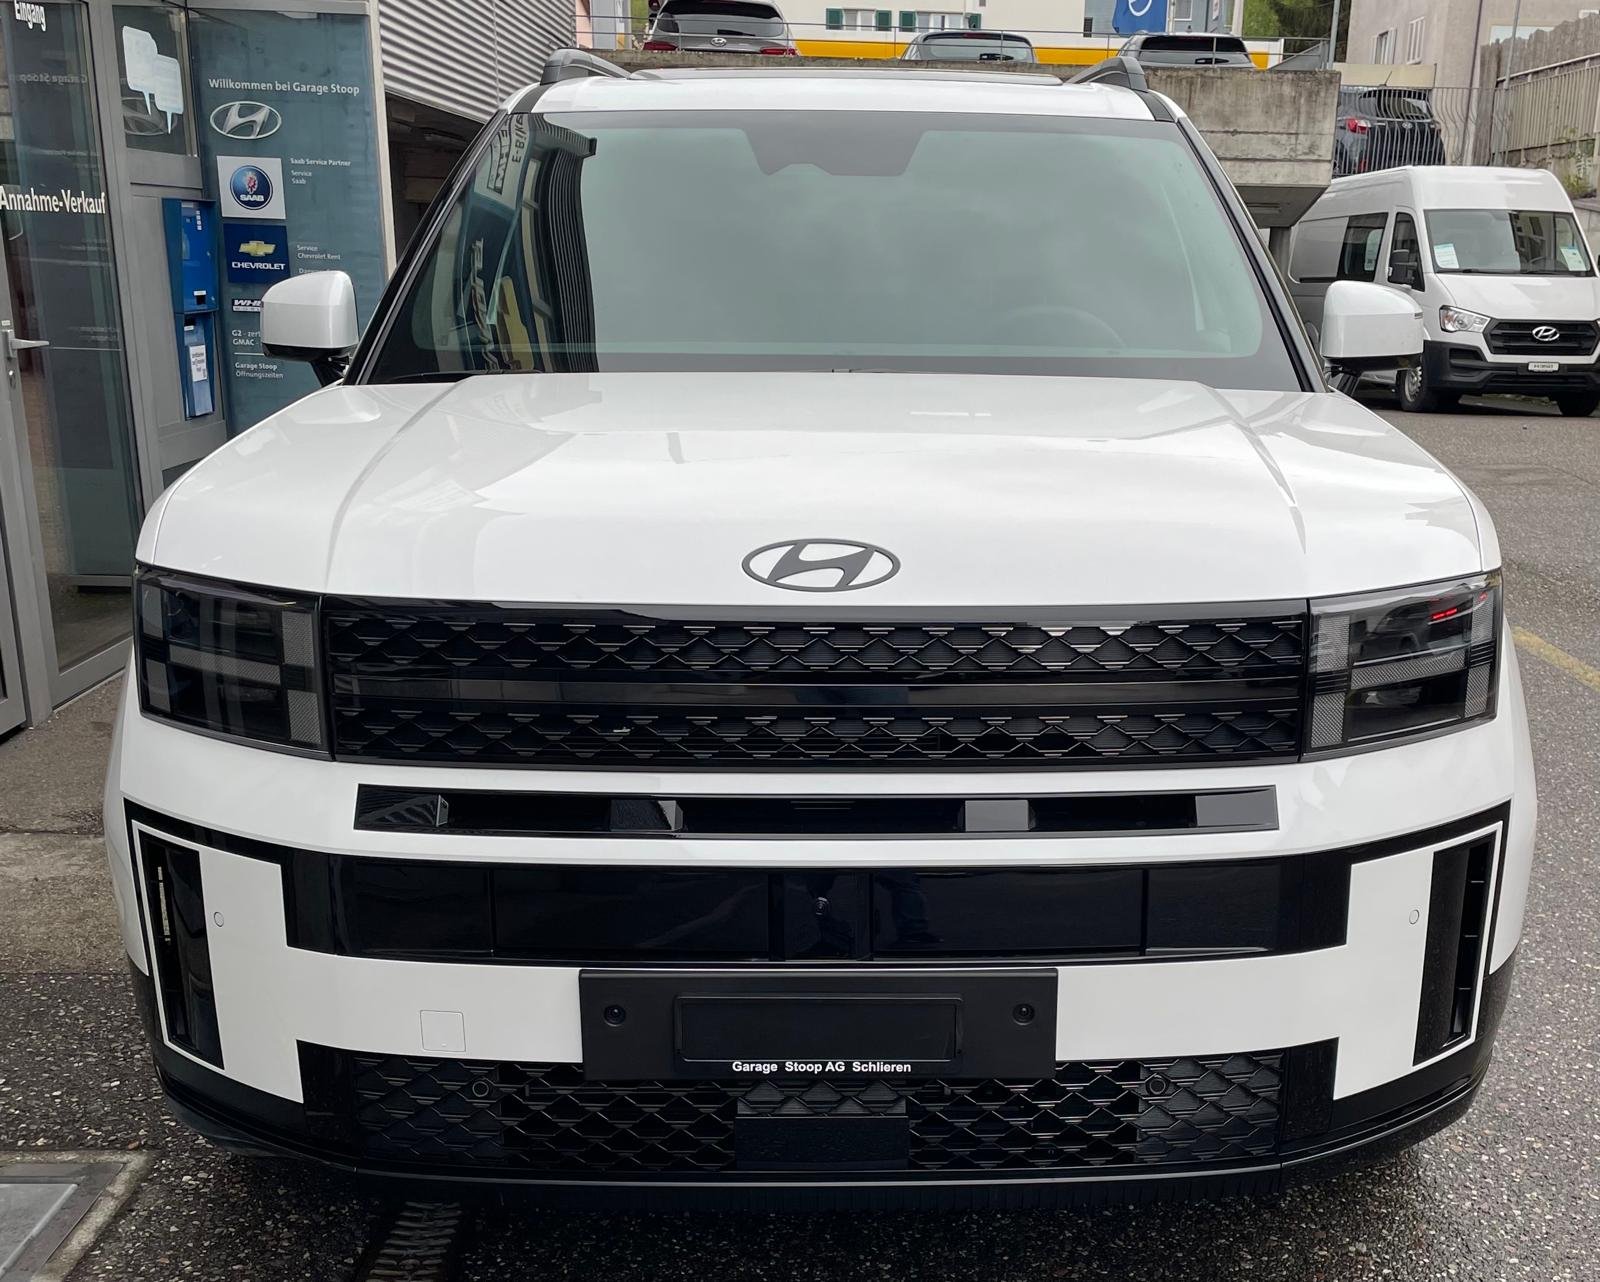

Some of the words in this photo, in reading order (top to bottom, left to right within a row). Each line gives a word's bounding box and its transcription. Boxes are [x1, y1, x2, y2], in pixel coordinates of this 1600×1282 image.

[14, 0, 46, 31] Eingang
[208, 78, 273, 90] Willkommen
[275, 80, 291, 91] bei
[292, 82, 329, 95] Garage
[330, 83, 360, 96] Stoop
[290, 157, 305, 165] Saab
[0, 185, 106, 214] Annahme-Verkauf
[239, 194, 264, 202] SAAB
[231, 261, 286, 270] CHEVROLET
[232, 338, 255, 346] GMAC
[234, 361, 258, 371] Garage
[258, 363, 278, 371] Stoop
[732, 1061, 778, 1075] Garage
[784, 1061, 823, 1074] Stoop
[825, 1061, 846, 1072] AG
[852, 1061, 912, 1073] Schlieren
